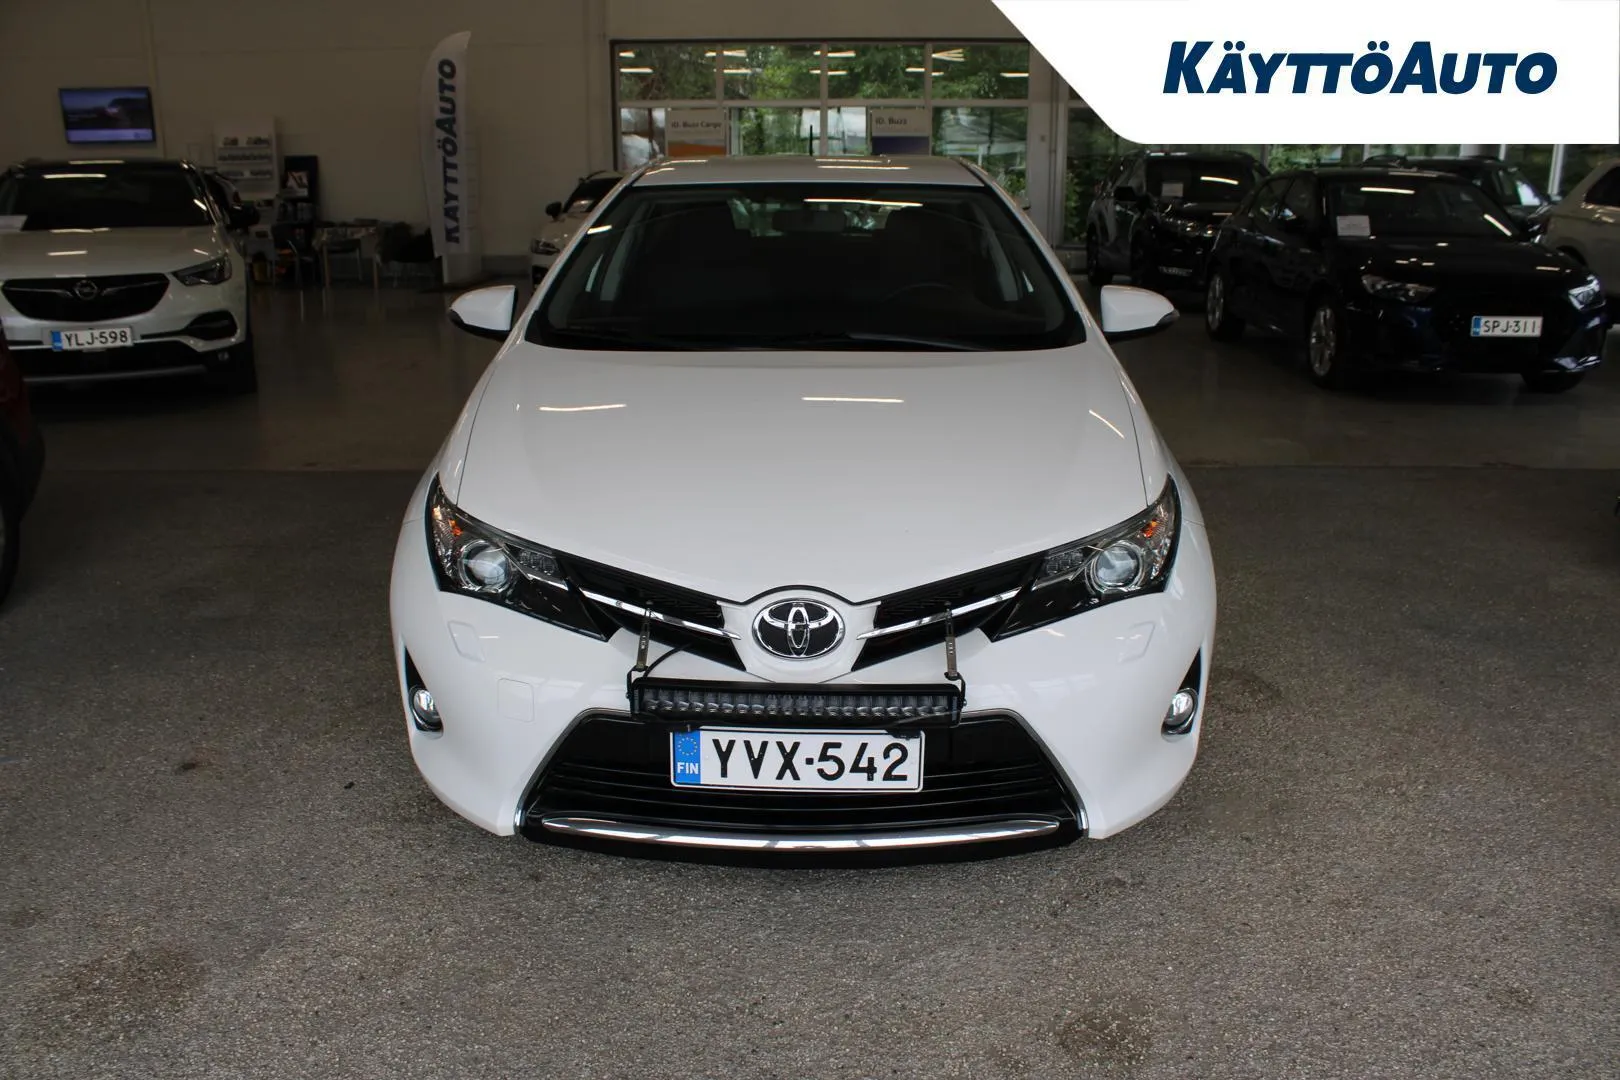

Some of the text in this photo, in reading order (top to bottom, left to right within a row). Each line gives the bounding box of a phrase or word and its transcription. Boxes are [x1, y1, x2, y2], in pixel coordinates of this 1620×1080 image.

[888, 116, 908, 125] Buzz
[1483, 319, 1536, 333] SPJ-311
[65, 330, 128, 346] YLJ-598
[677, 738, 909, 782] FIN YVX-542
